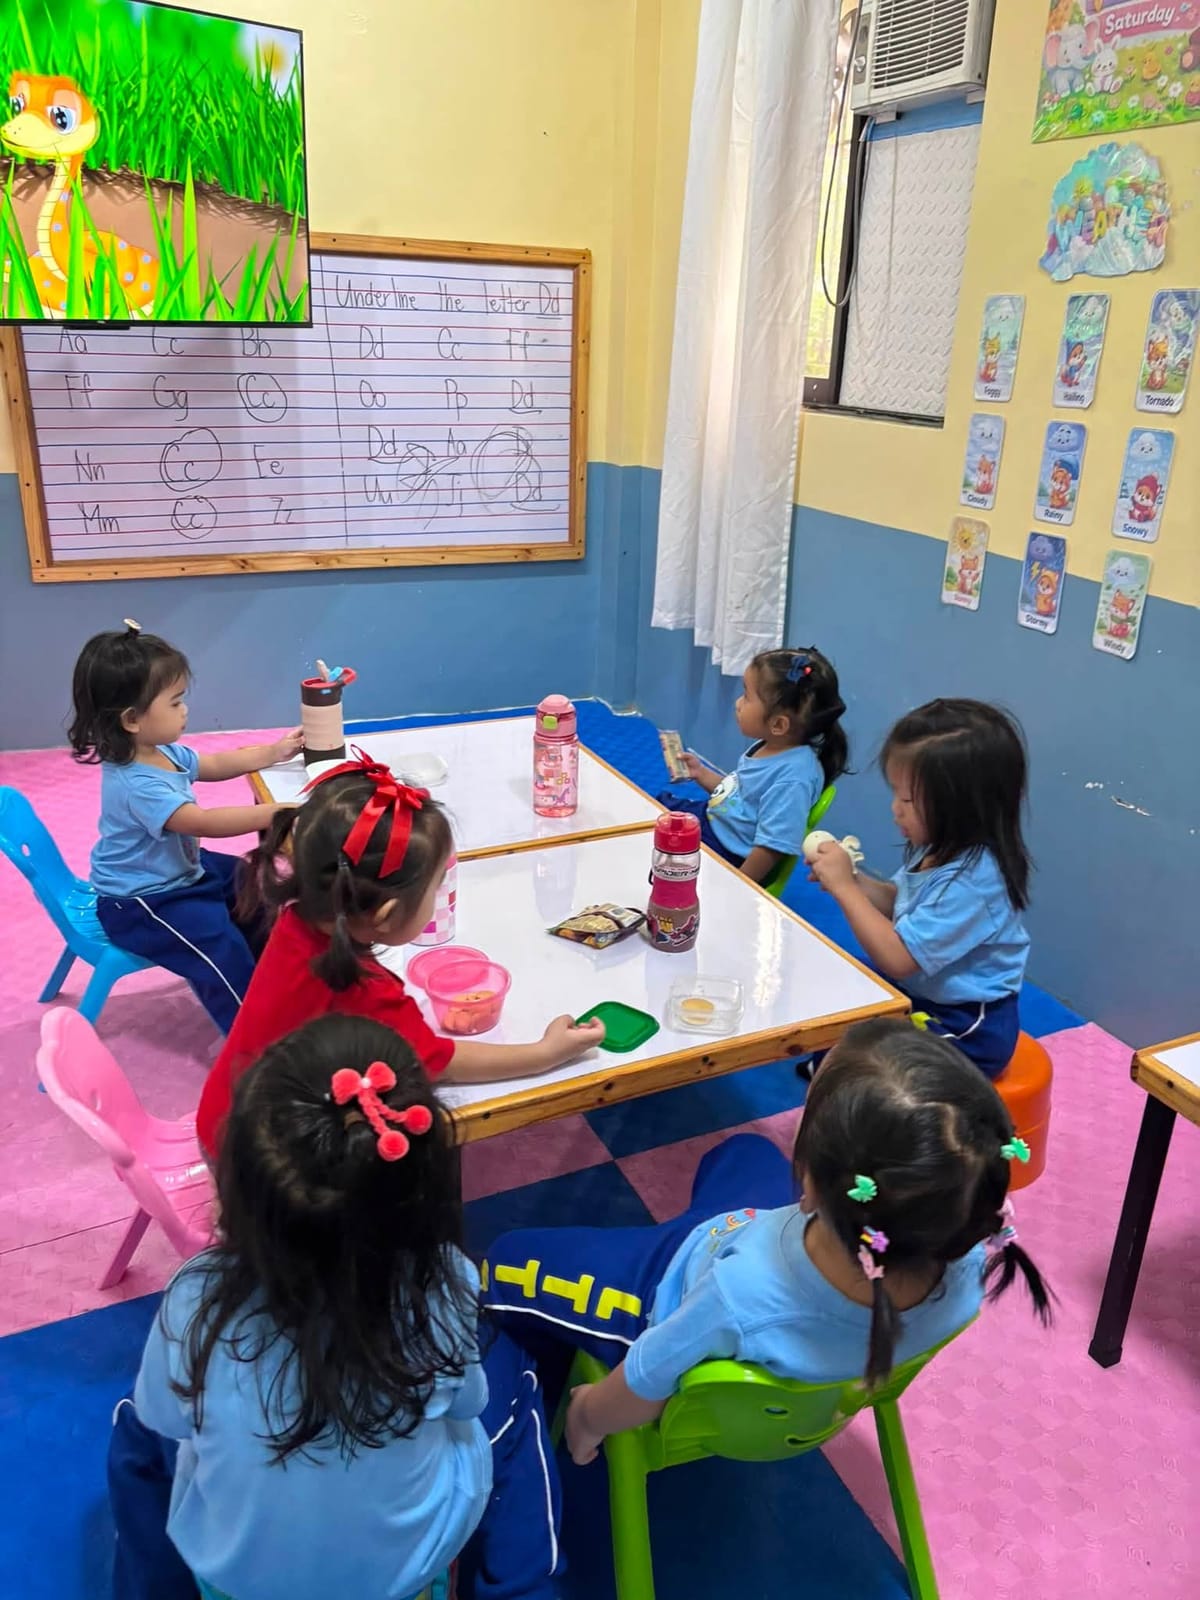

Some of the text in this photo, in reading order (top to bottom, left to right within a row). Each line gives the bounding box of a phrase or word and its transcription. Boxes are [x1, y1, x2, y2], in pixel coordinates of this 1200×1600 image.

[1104, 4, 1176, 35] Saturday
[335, 275, 417, 310] Underline
[483, 280, 530, 315] letter
[538, 281, 561, 314] Dd
[58, 328, 88, 354] Aa
[241, 327, 272, 357] Bb
[359, 325, 530, 361] Dd Cc Ff
[64, 374, 276, 422] Ff Gg Cc
[359, 378, 534, 422] Oo Pp Dd
[1145, 394, 1175, 407] Tornado
[367, 425, 398, 459] Dd
[446, 427, 468, 457] Aa
[74, 443, 284, 482] Nn Cc Ee
[363, 474, 393, 504] Uu
[515, 472, 543, 503] Dd
[967, 494, 989, 506] Cloudy
[77, 501, 120, 534] Mm
[1043, 508, 1065, 521] Rainy
[1122, 523, 1150, 538] Snowy
[1025, 614, 1049, 629] Stormy
